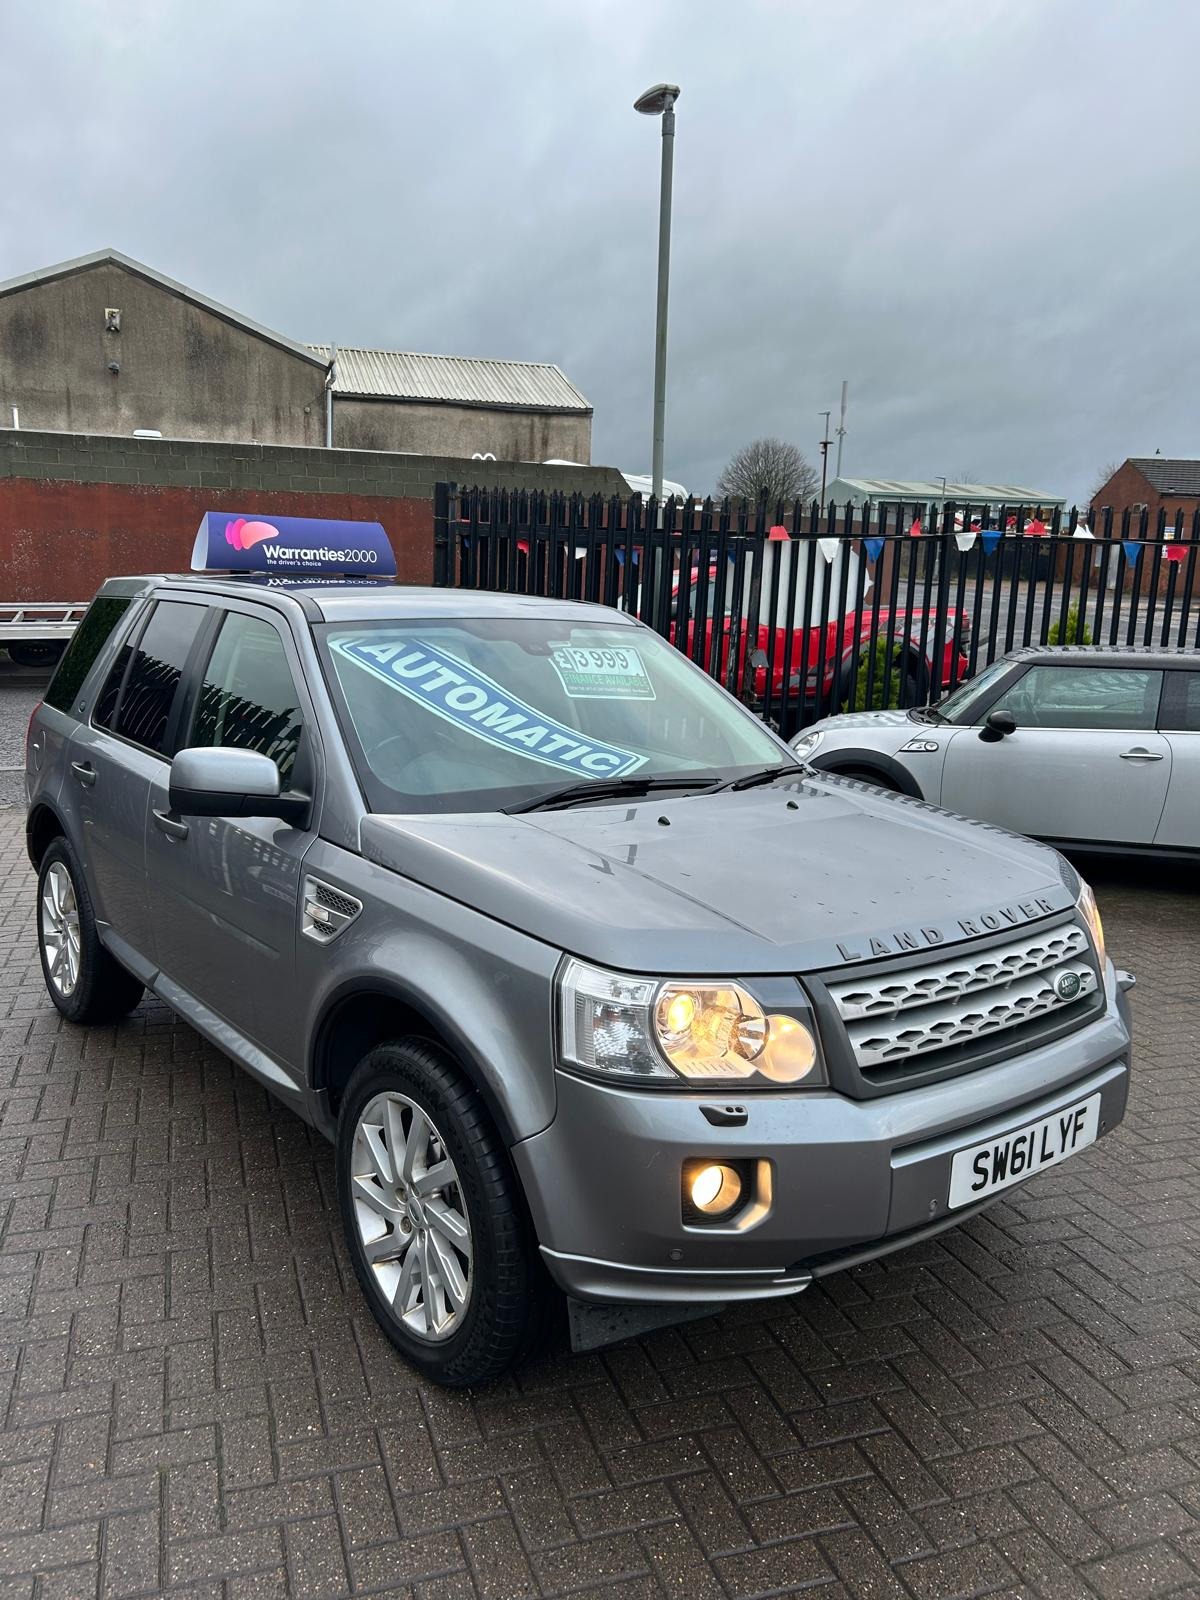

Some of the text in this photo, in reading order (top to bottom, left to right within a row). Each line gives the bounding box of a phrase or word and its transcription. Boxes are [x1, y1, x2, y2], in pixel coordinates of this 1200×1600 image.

[262, 544, 378, 563] Warranties2000
[357, 641, 622, 771] AUTOMATIC
[836, 897, 1056, 961] LAND ROVER
